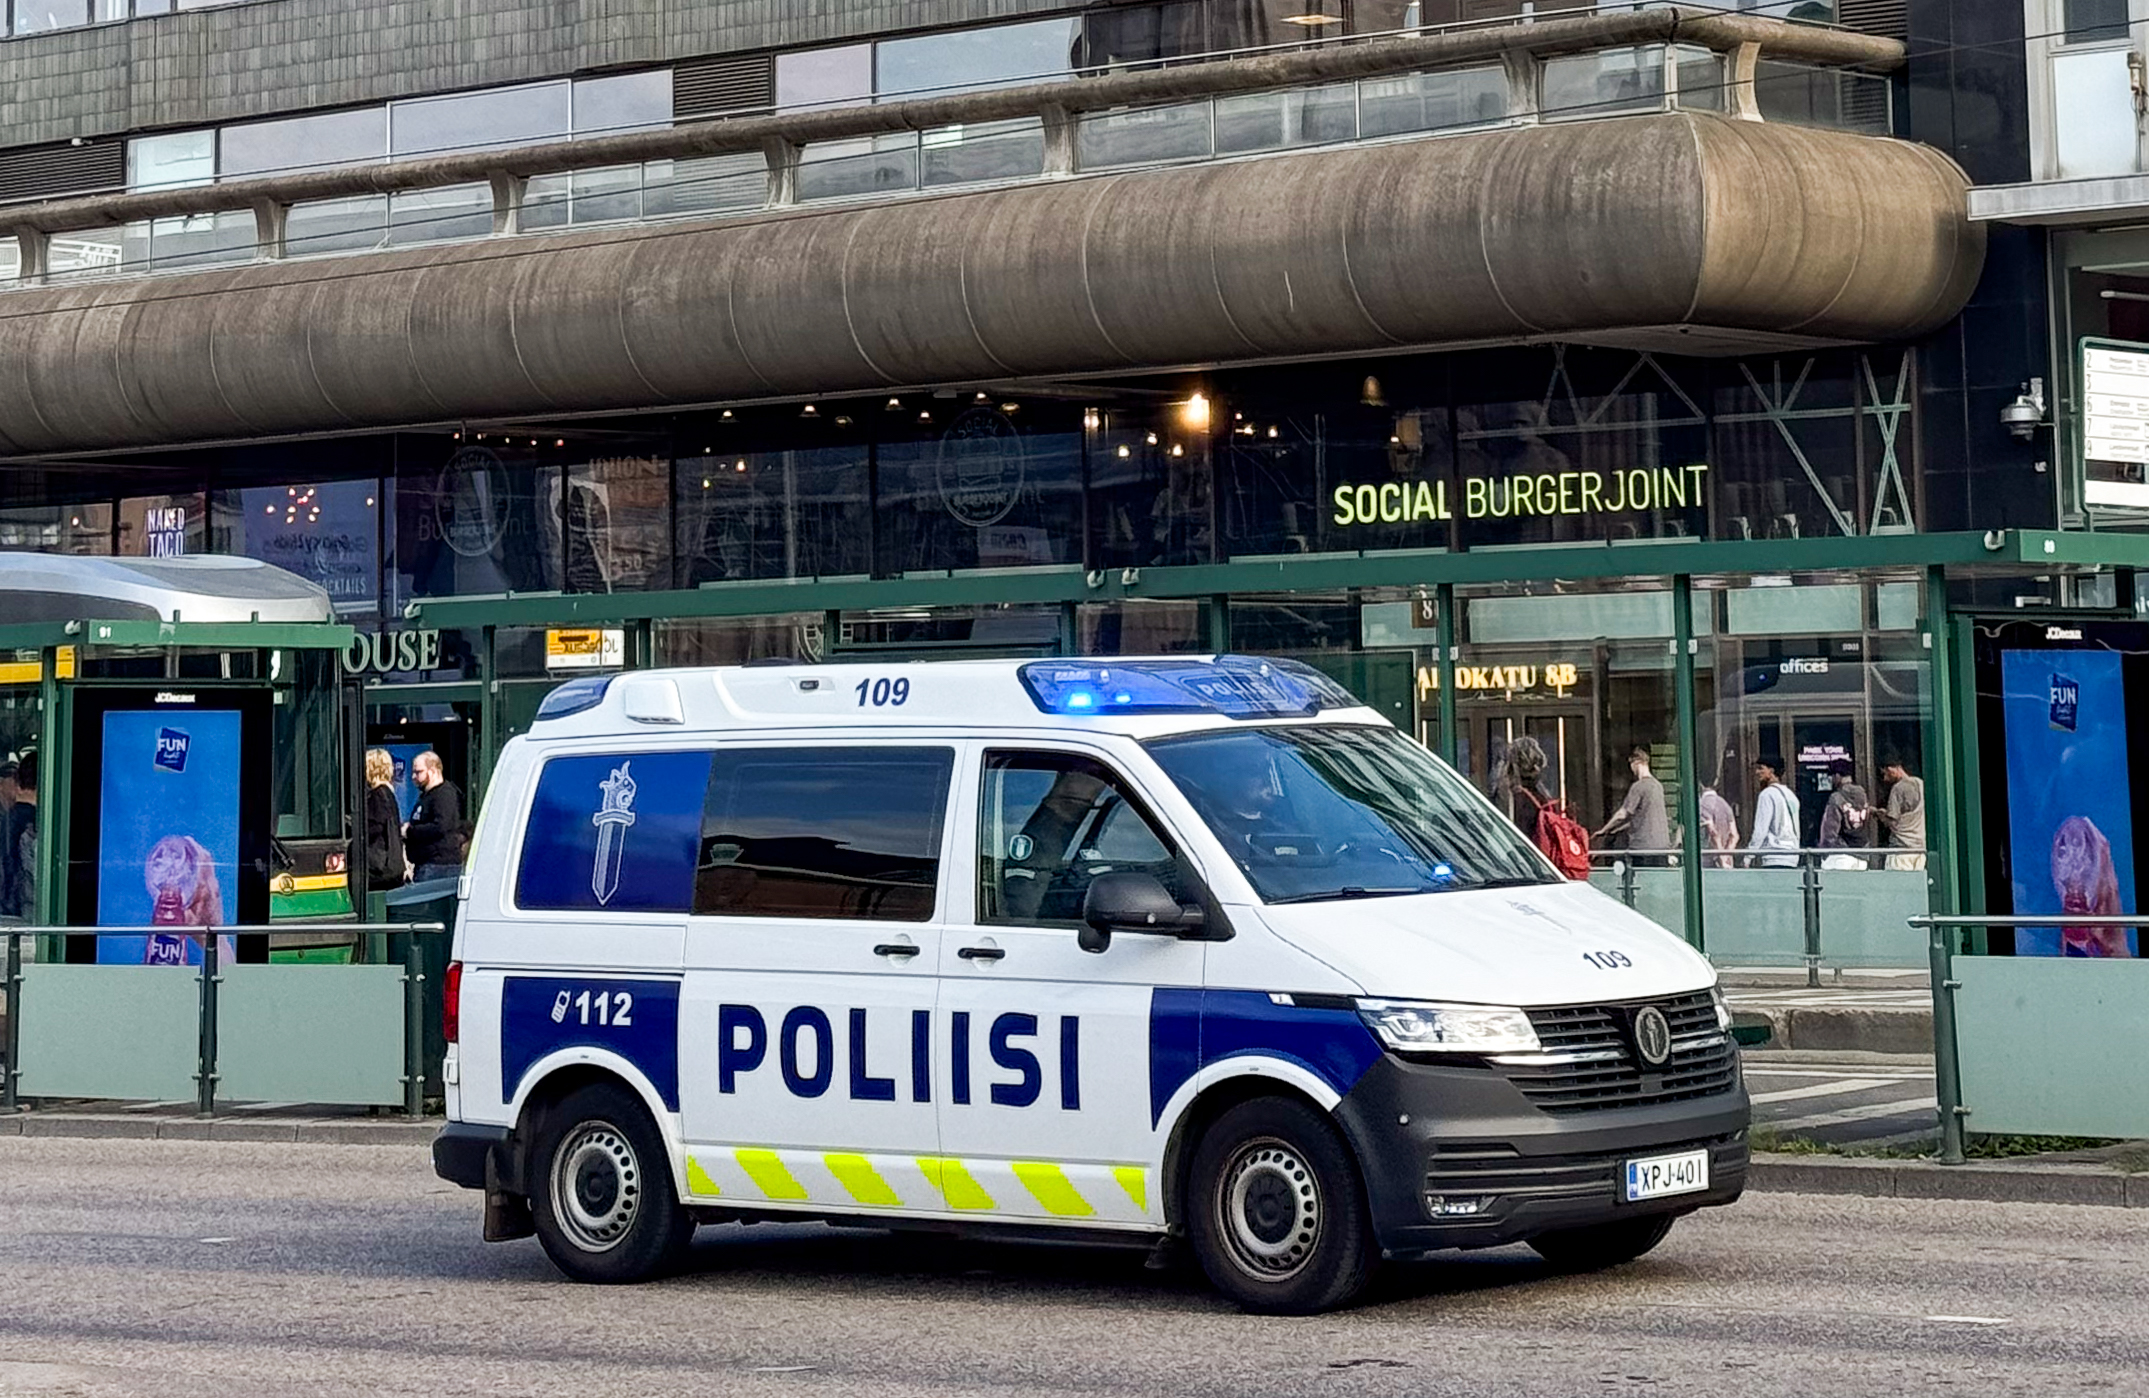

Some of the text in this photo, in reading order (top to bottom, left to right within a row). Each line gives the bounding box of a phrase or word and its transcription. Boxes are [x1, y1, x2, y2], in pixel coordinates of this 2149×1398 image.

[1334, 480, 1452, 525] SOCIAL
[148, 507, 185, 532] NAKED
[148, 533, 184, 558] TACO
[1418, 666, 1536, 690] AIOKATU
[1780, 659, 1828, 673] offices
[855, 677, 909, 707] 109
[2050, 687, 2076, 705] FUN
[157, 738, 186, 752] FUN
[152, 943, 180, 960] FUN
[1583, 951, 1632, 970] 109
[576, 990, 632, 1026] 112
[718, 1004, 1080, 1111] POLIISI
[1640, 1158, 1702, 1192] XPJ-401
